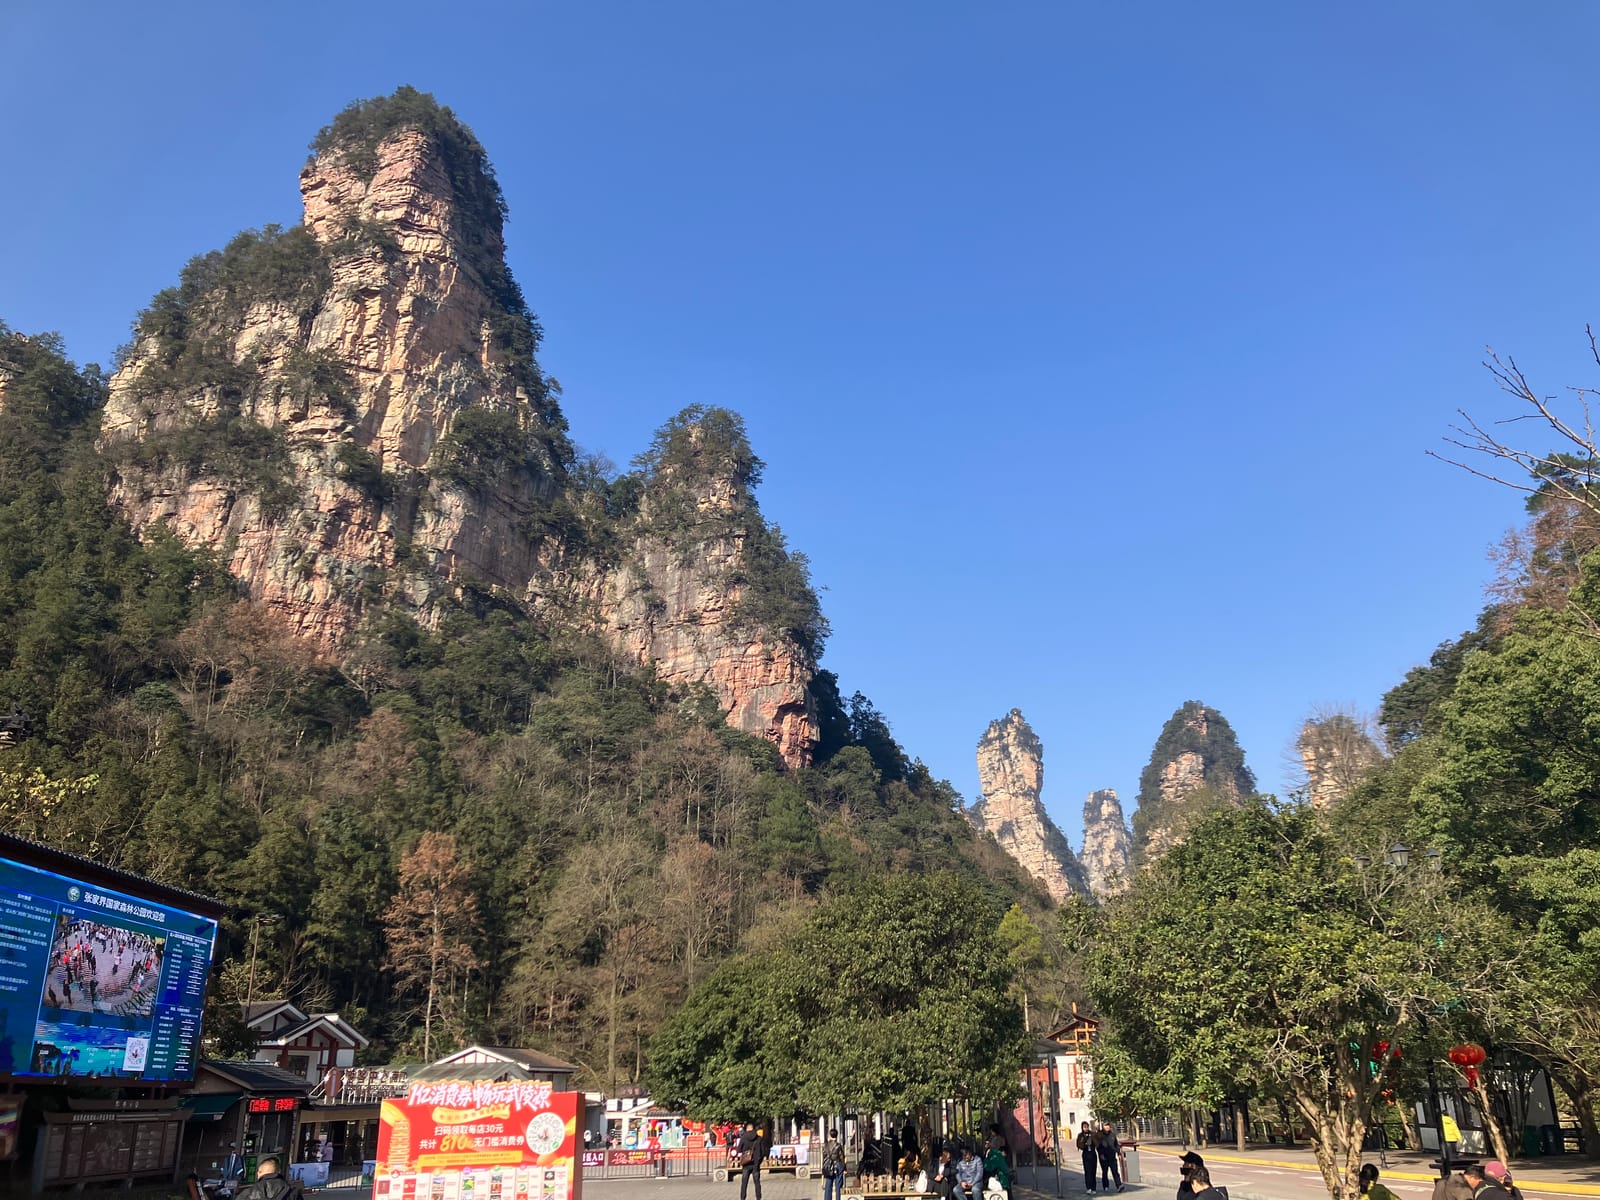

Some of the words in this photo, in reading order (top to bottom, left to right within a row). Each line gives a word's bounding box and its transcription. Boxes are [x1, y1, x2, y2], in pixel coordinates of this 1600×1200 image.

[83, 891, 165, 922] 张家界国家森林公园欢迎您
[434, 1123, 504, 1136] 扫码领取每店30元
